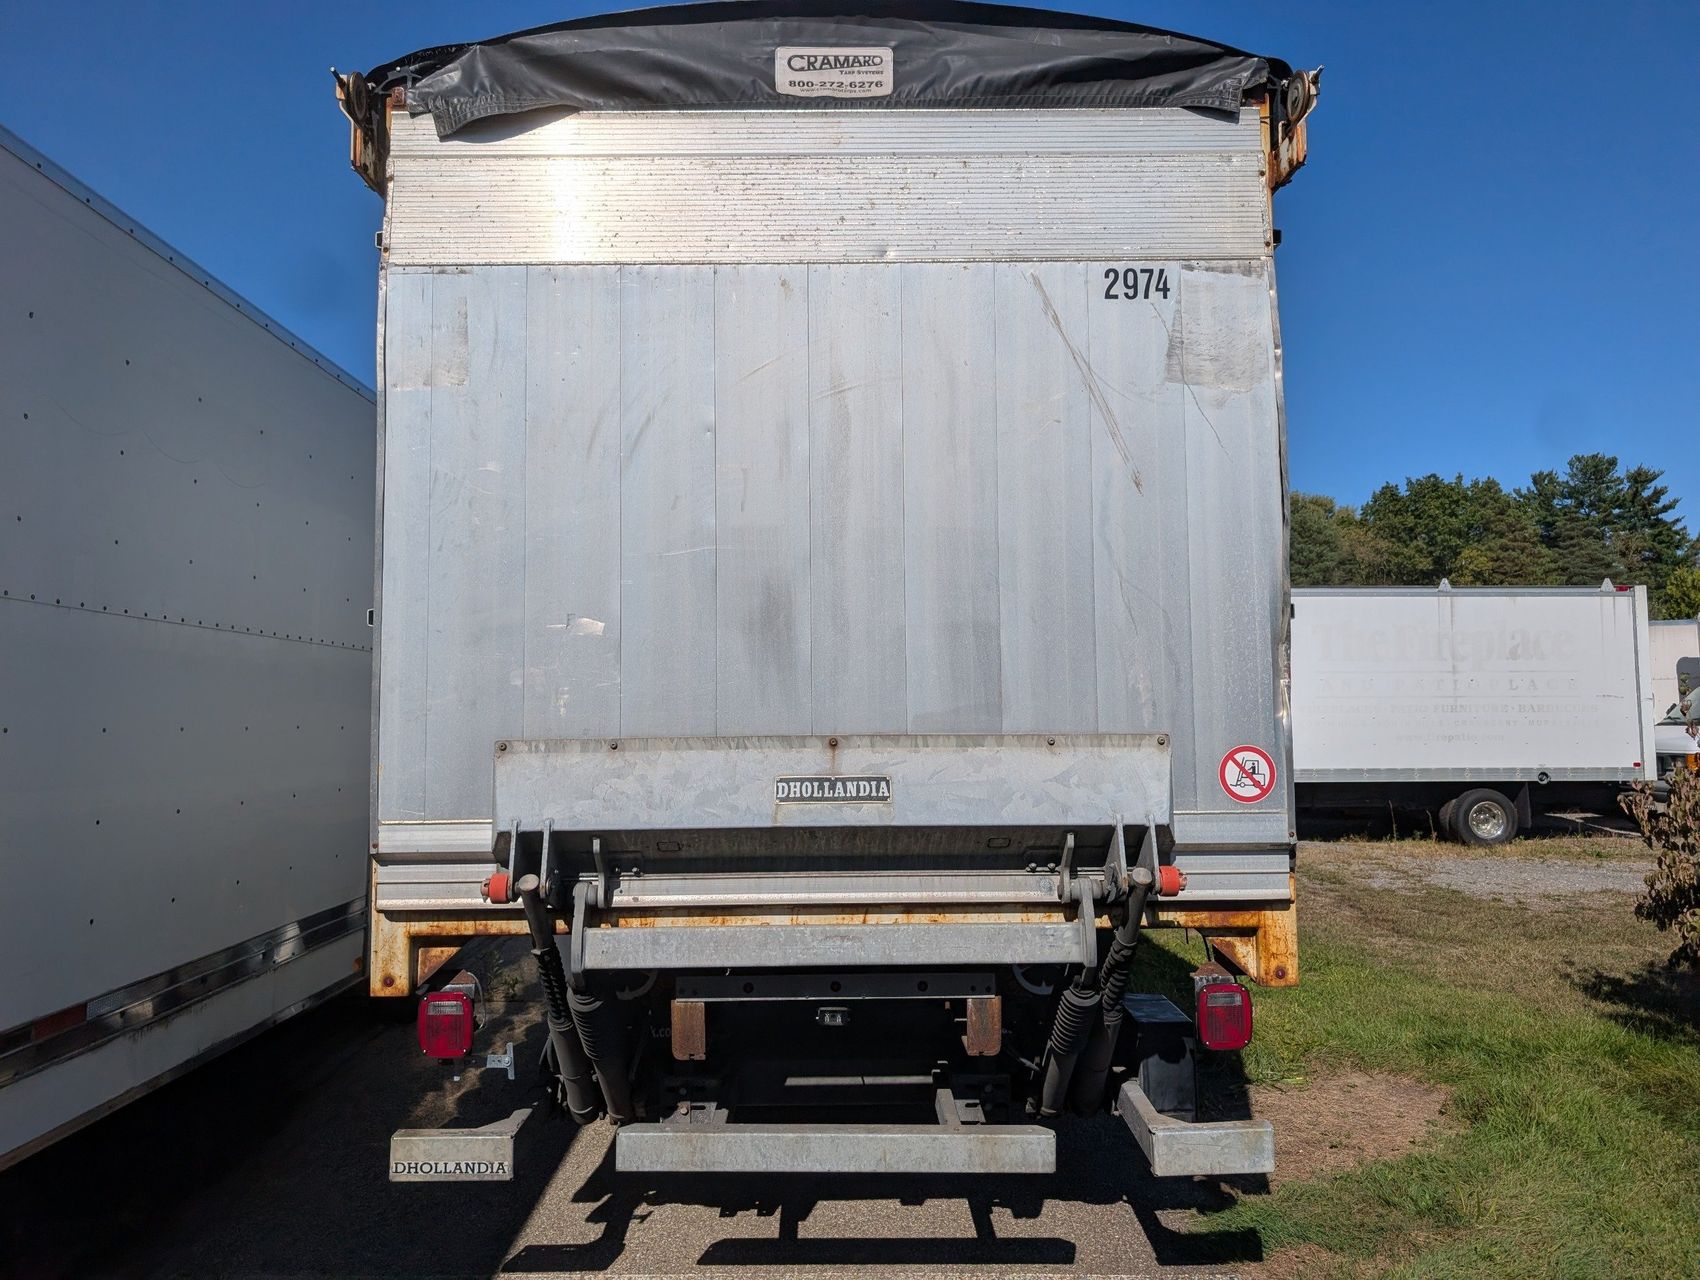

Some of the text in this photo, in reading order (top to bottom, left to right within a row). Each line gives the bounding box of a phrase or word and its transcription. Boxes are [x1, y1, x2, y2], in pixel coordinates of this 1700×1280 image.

[787, 54, 883, 72] CRAMARO
[788, 80, 883, 89] 800-272-6276
[1104, 267, 1170, 300] 2974
[777, 781, 889, 798] DHOLLANDIA
[393, 1162, 507, 1174] DHOLLANDIA
